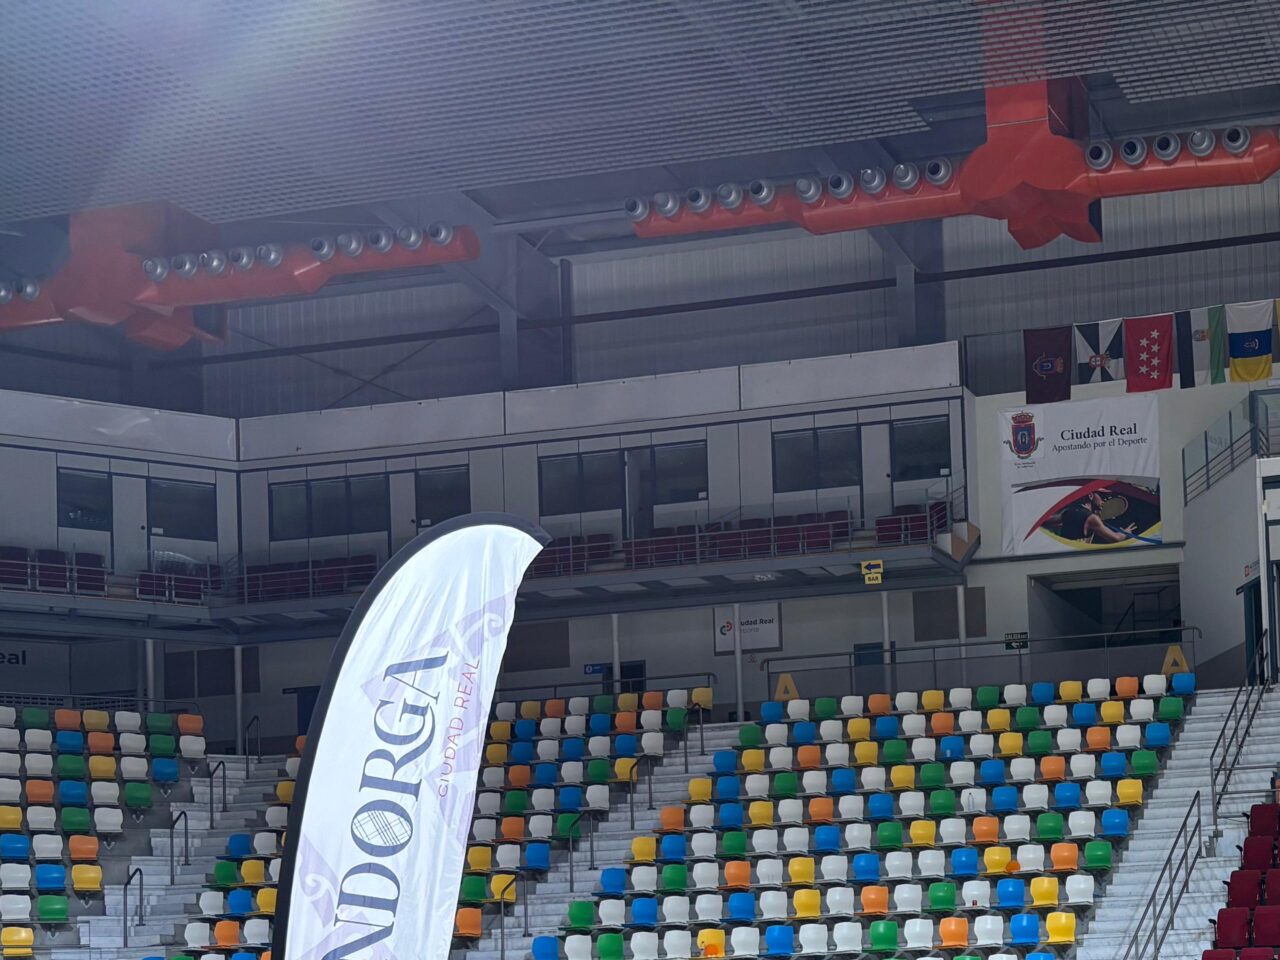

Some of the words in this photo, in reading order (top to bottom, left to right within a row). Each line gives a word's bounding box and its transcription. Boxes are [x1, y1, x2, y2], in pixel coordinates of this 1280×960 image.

[1060, 426, 1105, 441] Ciudad
[1109, 423, 1137, 437] Real
[1052, 441, 1091, 453] Apostando
[1093, 439, 1106, 450] por
[1109, 435, 1116, 447] el
[1118, 437, 1148, 448] Deporte
[0, 650, 27, 664] eal
[1161, 645, 1190, 676] A
[774, 672, 800, 701] A
[438, 717, 465, 797] CIUDAD
[453, 659, 480, 710] REAL
